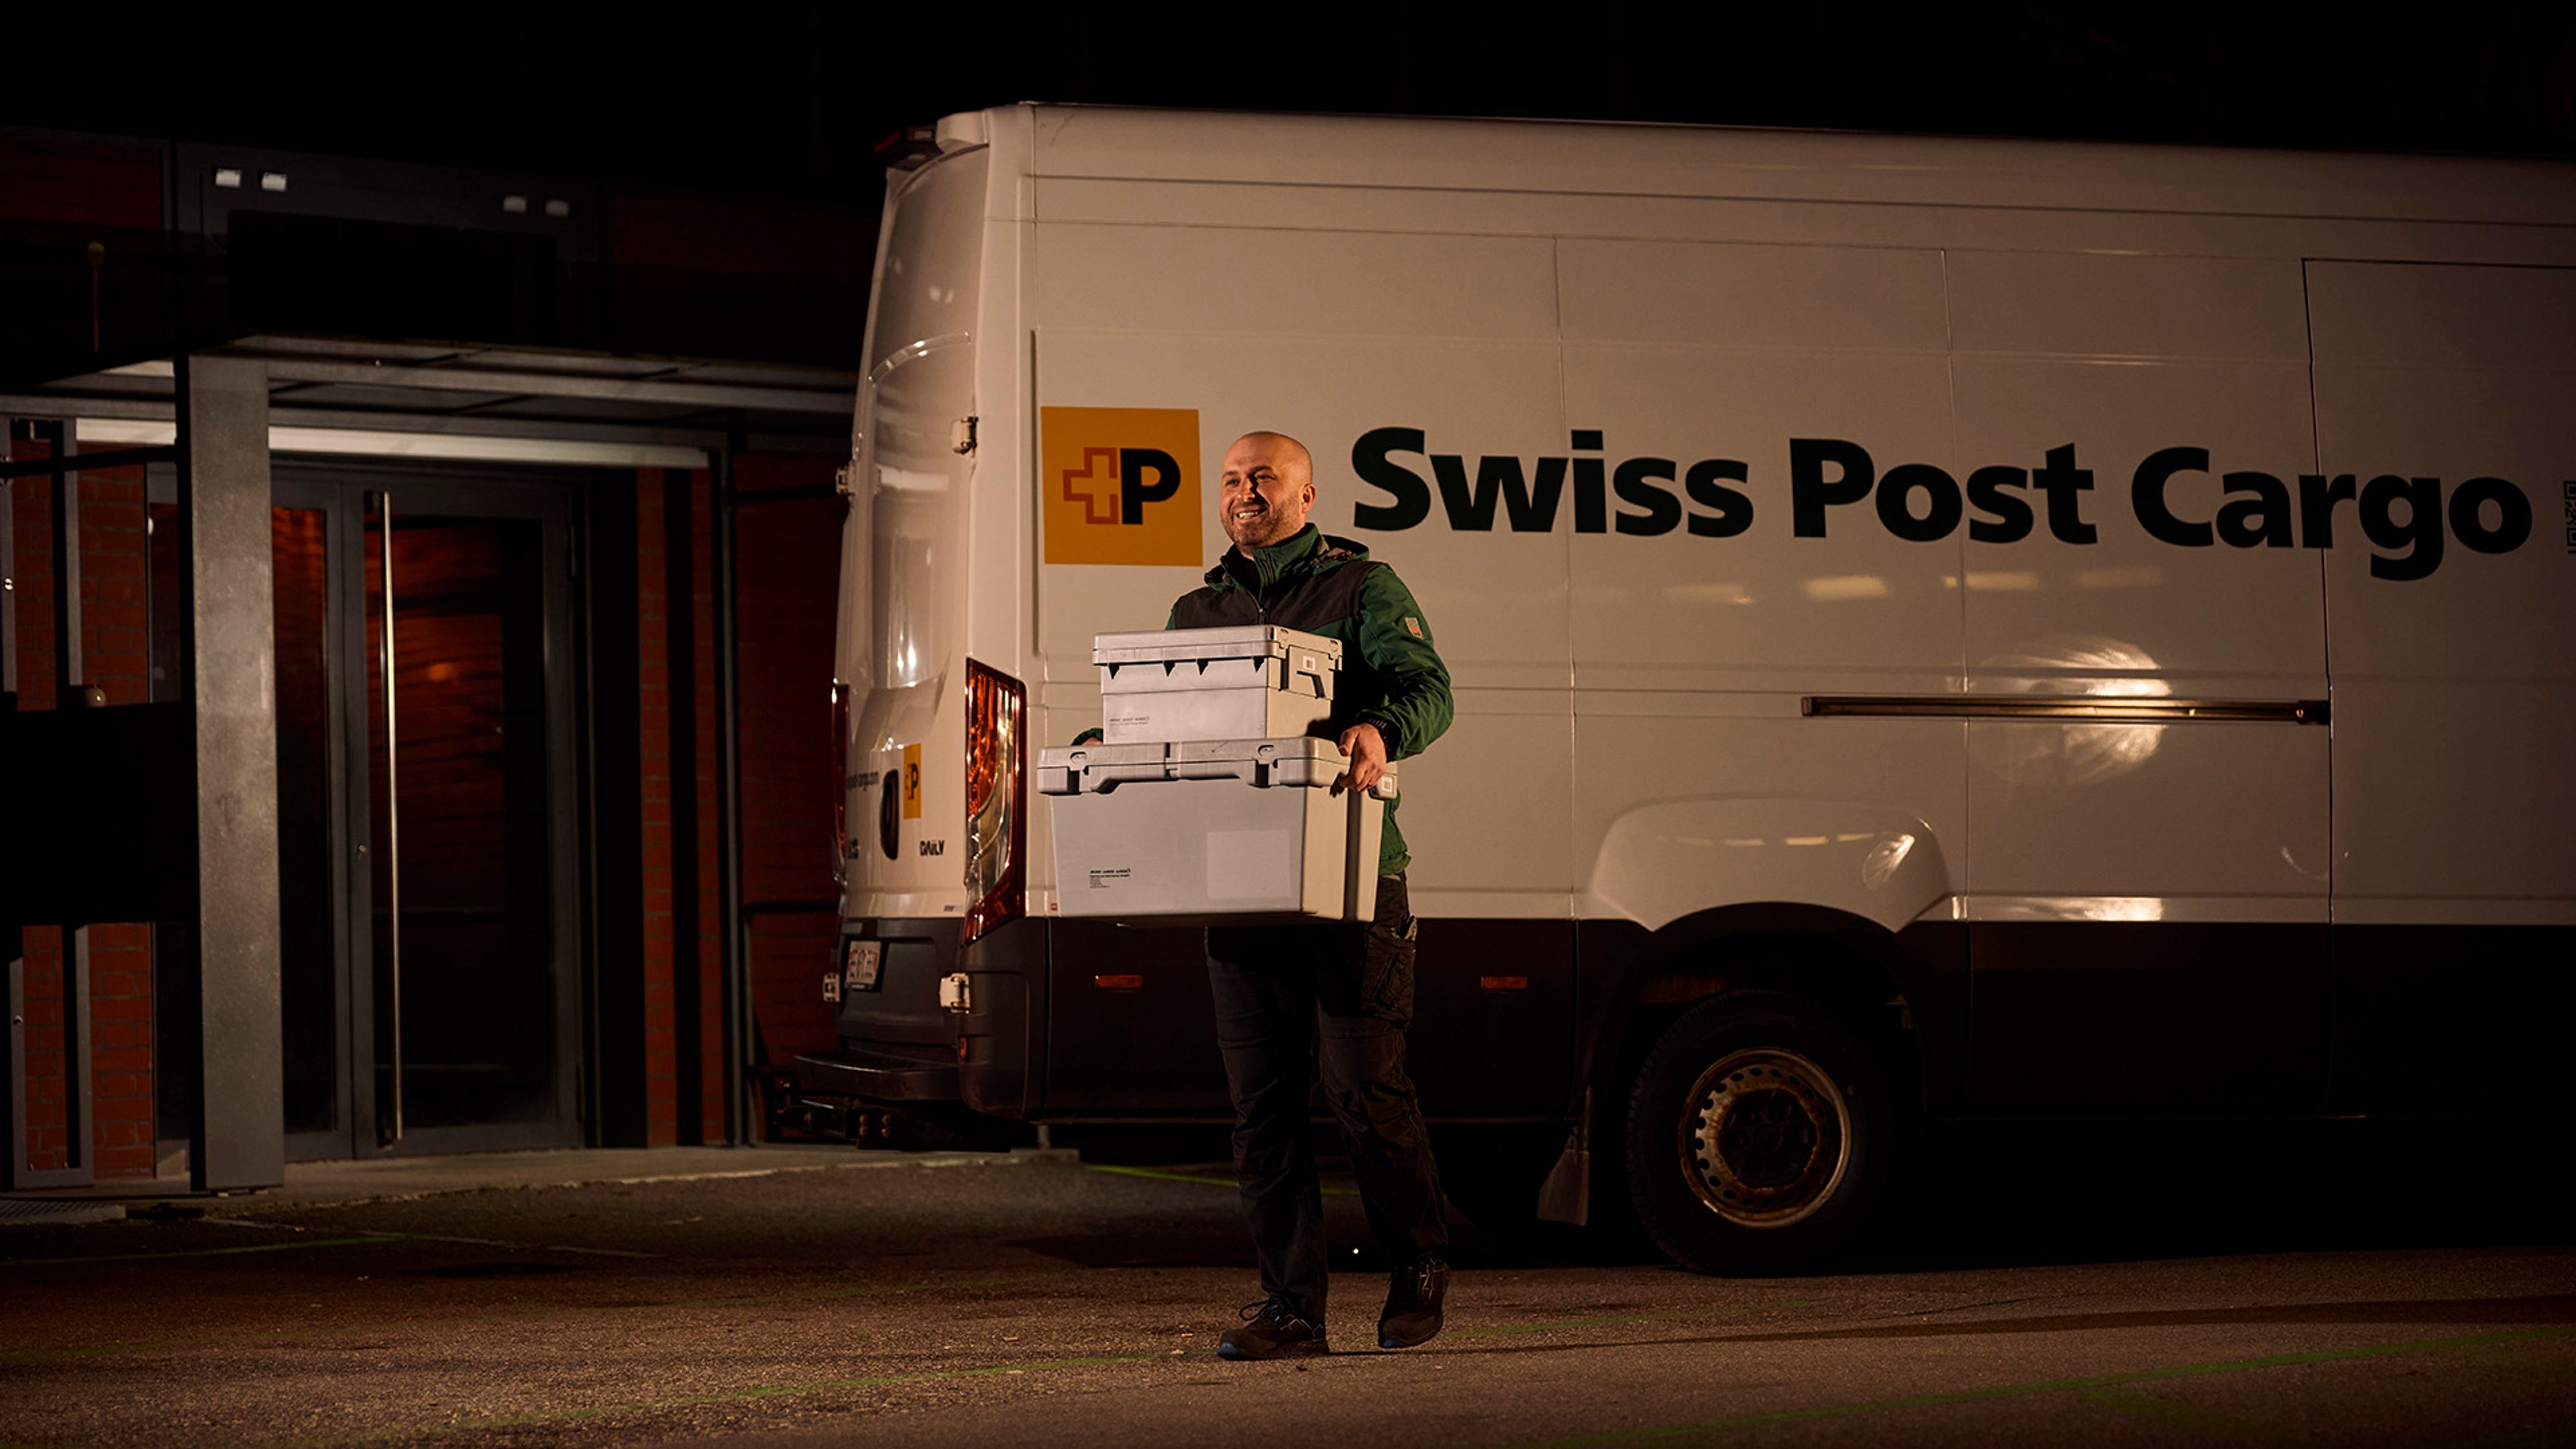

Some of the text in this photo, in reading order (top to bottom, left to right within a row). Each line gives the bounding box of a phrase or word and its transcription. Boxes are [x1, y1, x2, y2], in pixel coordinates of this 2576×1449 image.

[1352, 427, 2533, 582] Swiss Post Cargo
[920, 840, 945, 856] DAILY
